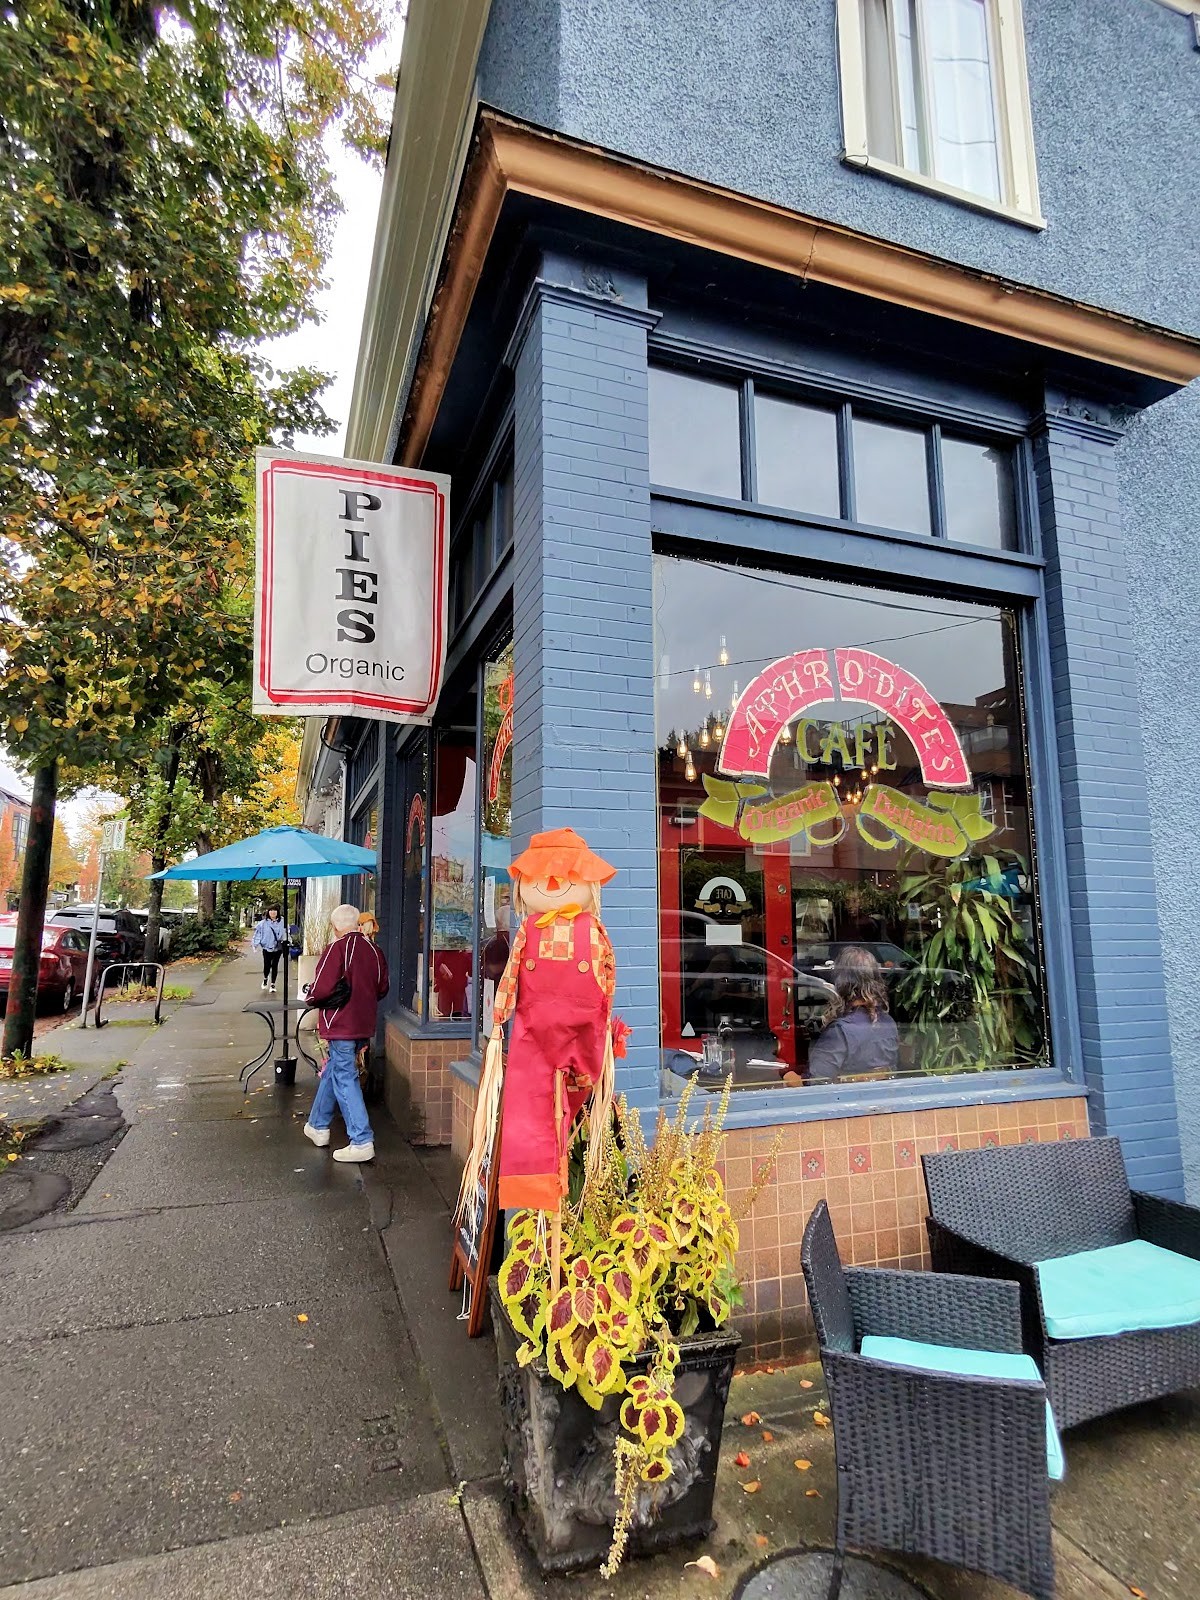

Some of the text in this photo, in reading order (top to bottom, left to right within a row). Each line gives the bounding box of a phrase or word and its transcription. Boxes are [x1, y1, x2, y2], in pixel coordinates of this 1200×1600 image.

[335, 489, 382, 644] PIES
[305, 653, 405, 681] Organic
[746, 788, 956, 844] Organic Delights
